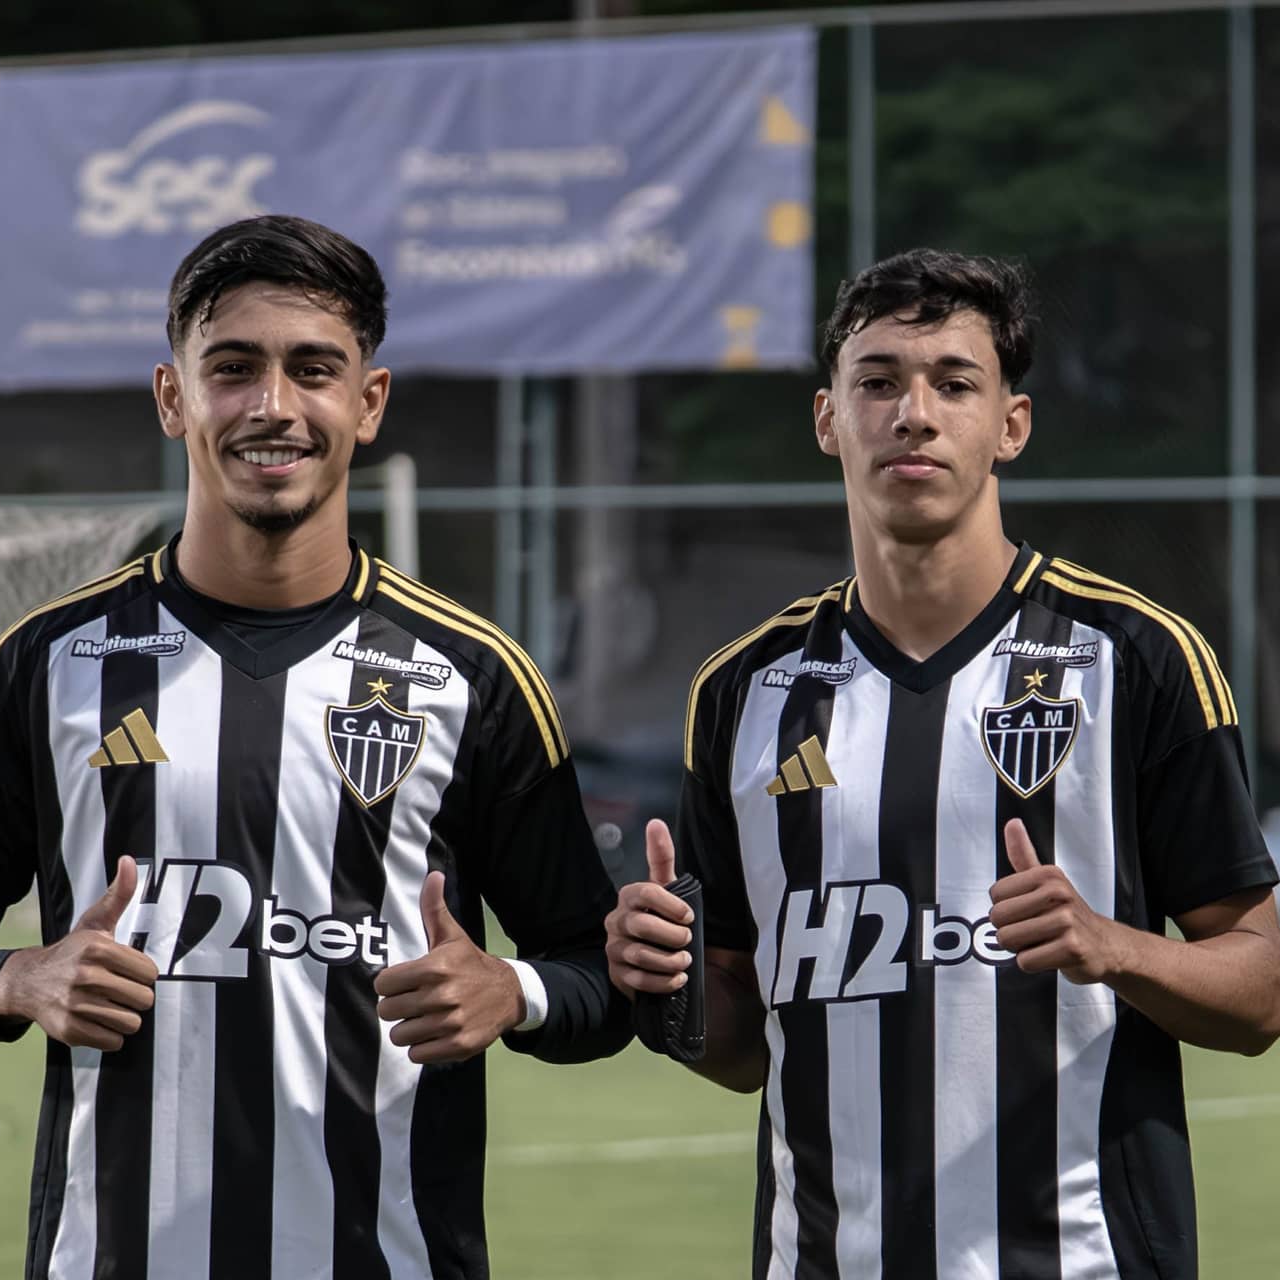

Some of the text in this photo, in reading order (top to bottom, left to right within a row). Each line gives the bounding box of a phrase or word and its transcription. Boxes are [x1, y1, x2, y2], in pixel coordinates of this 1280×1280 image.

[73, 632, 185, 655] Multimarcas
[994, 640, 1098, 657] Multimarcas
[334, 641, 451, 679] Multimarcas
[764, 658, 856, 687] Mumarcas
[342, 717, 410, 741] CAM
[997, 710, 1063, 728] CAM
[922, 909, 1017, 960] be
